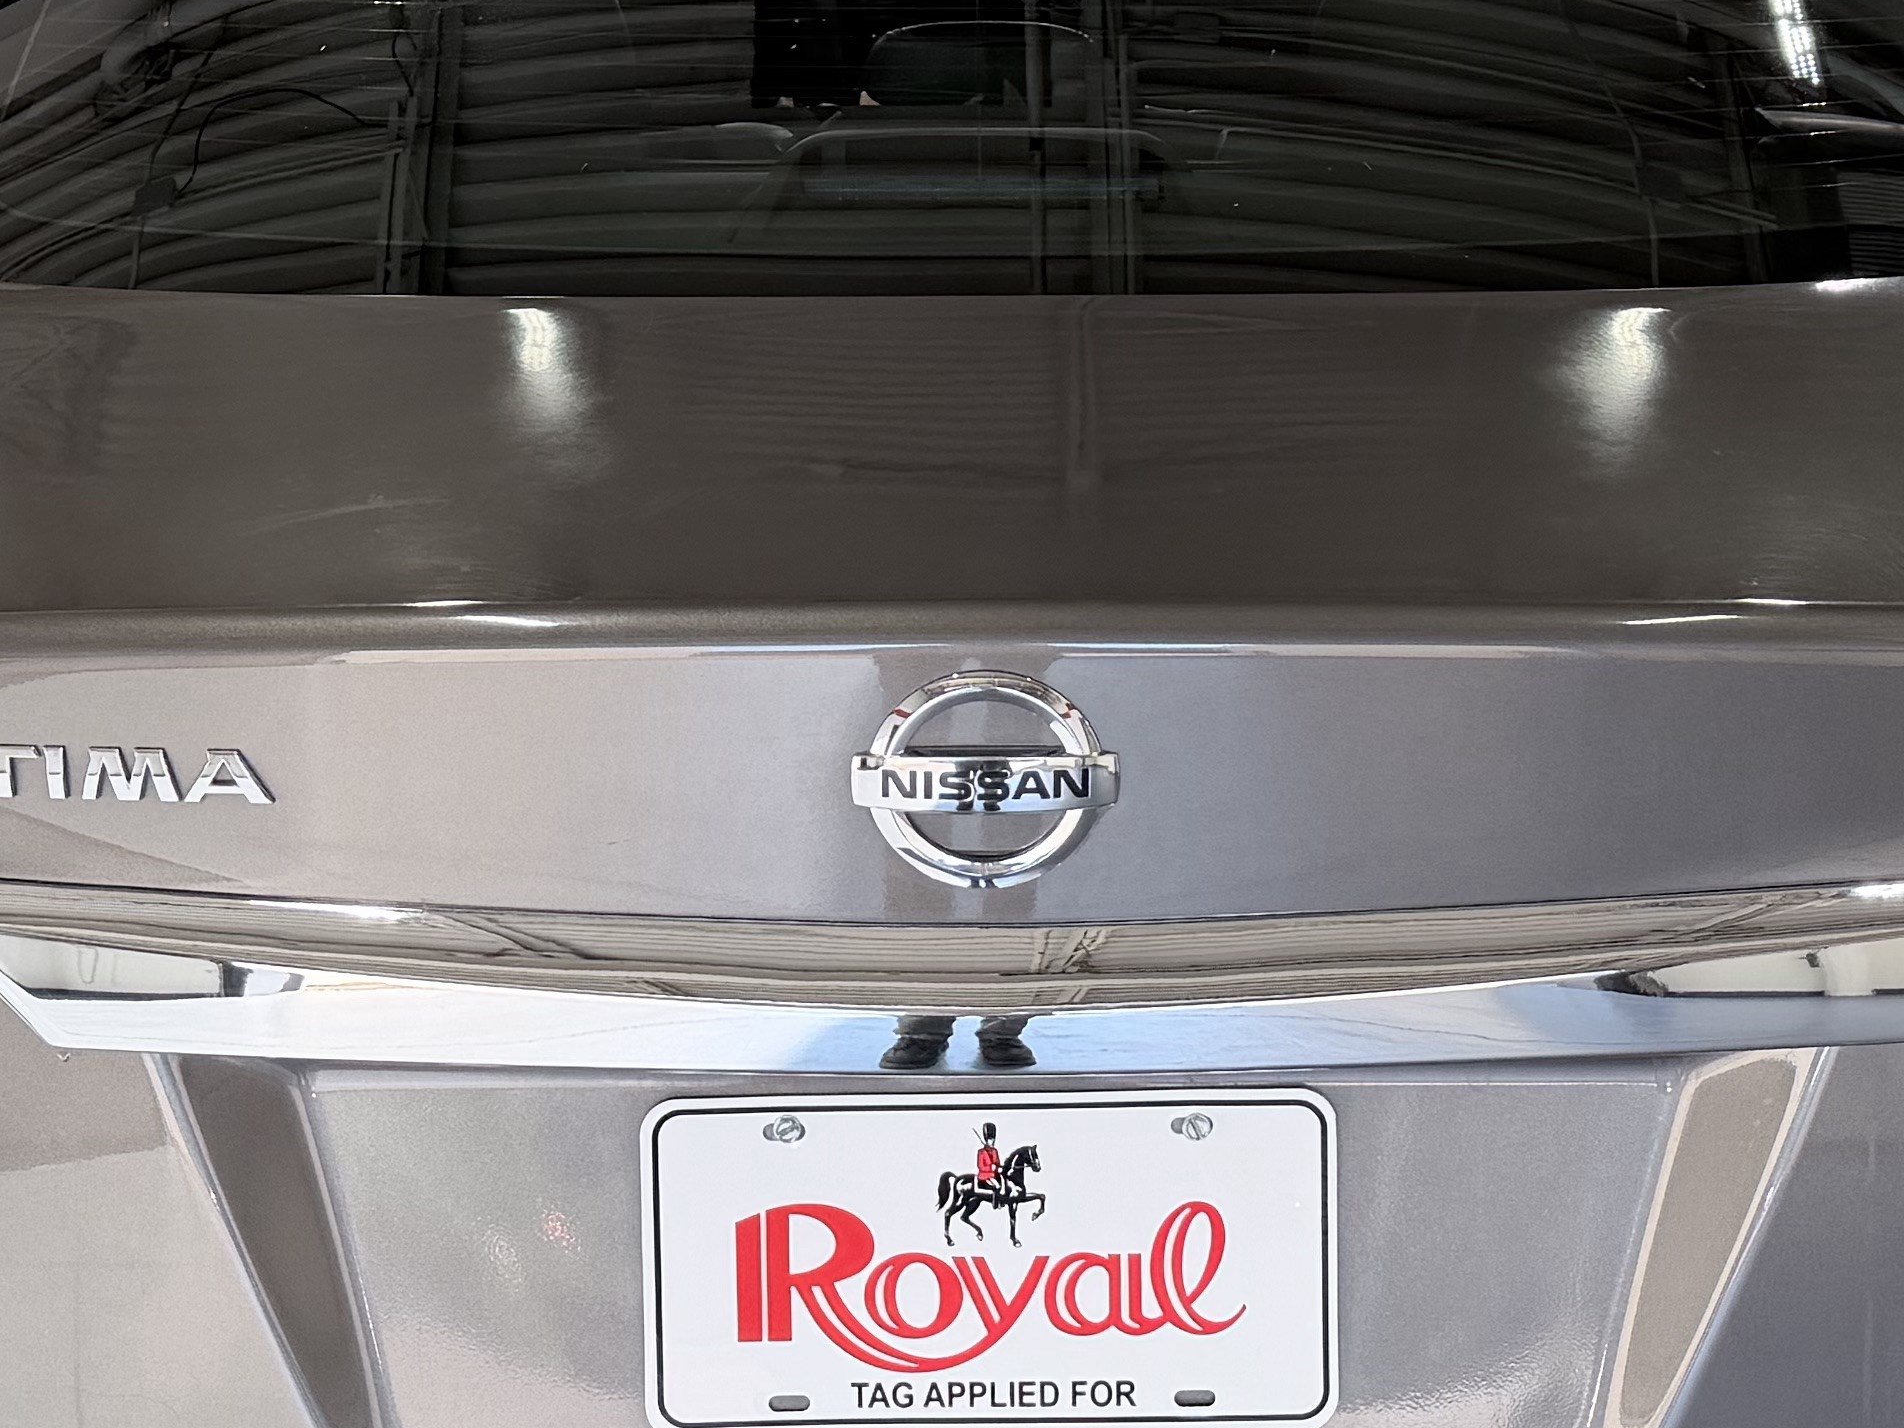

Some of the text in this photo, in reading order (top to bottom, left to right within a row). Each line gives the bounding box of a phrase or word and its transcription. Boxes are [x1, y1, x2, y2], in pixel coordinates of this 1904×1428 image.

[881, 767, 1090, 803] NISSAN
[735, 1201, 1247, 1373] Royal
[850, 1380, 1136, 1409] TAG APPLIED FOR
